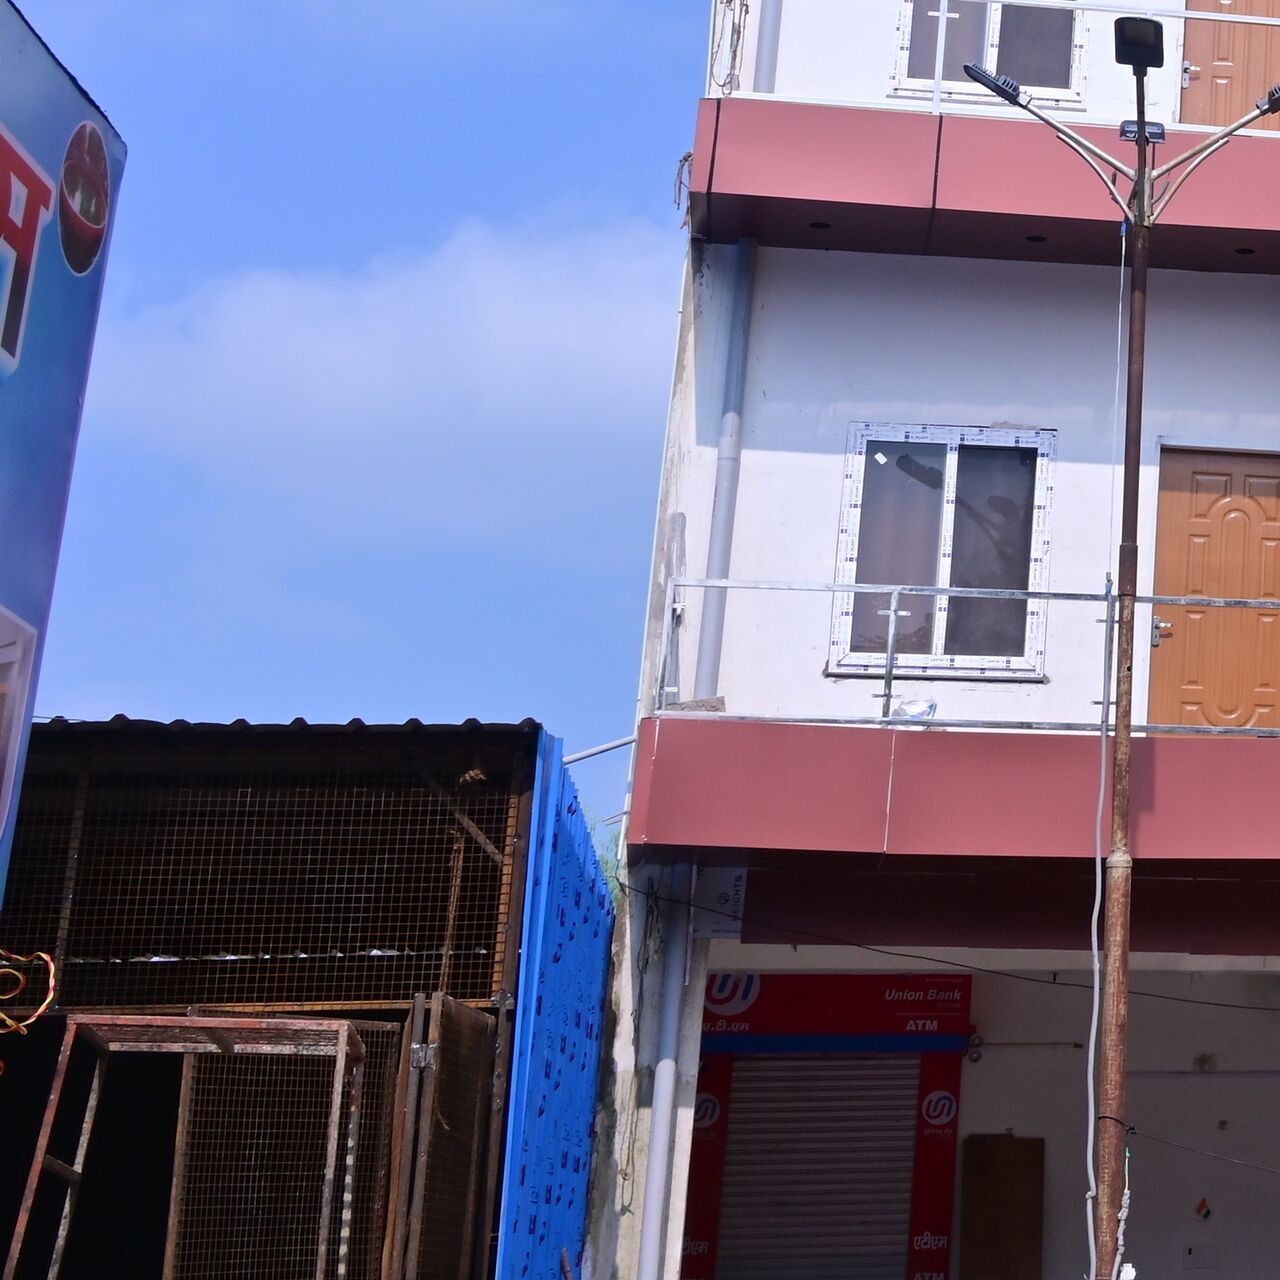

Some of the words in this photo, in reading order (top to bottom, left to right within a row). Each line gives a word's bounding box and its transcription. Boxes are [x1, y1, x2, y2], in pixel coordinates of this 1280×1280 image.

[885, 988, 924, 1001] Union
[926, 988, 962, 1001] Bank
[906, 1019, 939, 1032] ATM
[913, 1231, 949, 1251] एटीएम
